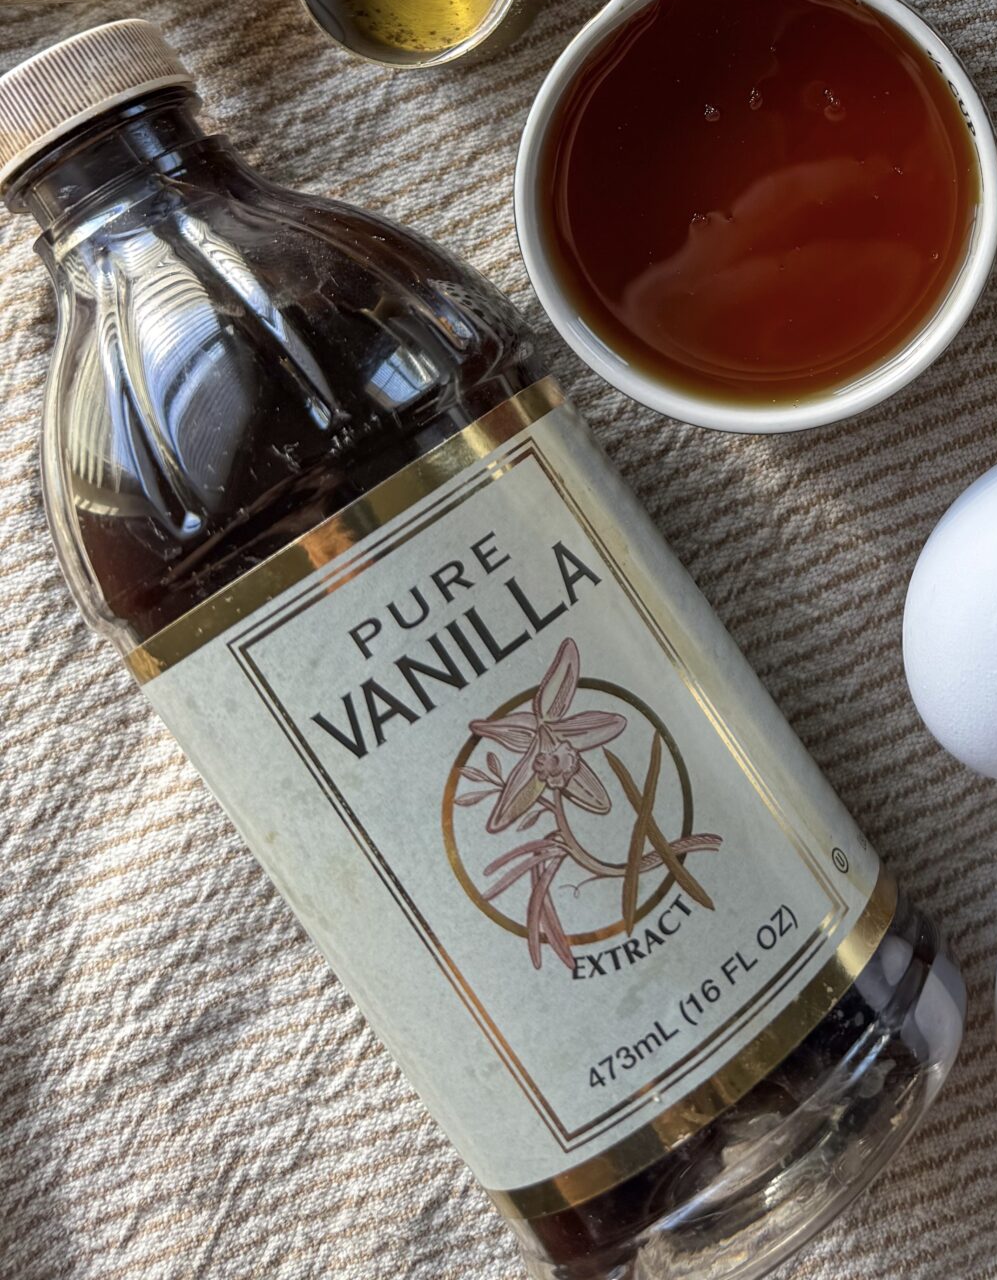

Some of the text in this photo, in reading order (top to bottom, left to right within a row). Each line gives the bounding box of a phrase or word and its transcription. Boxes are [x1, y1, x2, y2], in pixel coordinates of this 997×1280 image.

[947, 79, 976, 136] CUP
[311, 541, 602, 759] VANILLA
[348, 531, 512, 660] PURE
[572, 894, 693, 980] EXTRACT
[589, 904, 798, 1089] 473mL (16 FL OZ)
